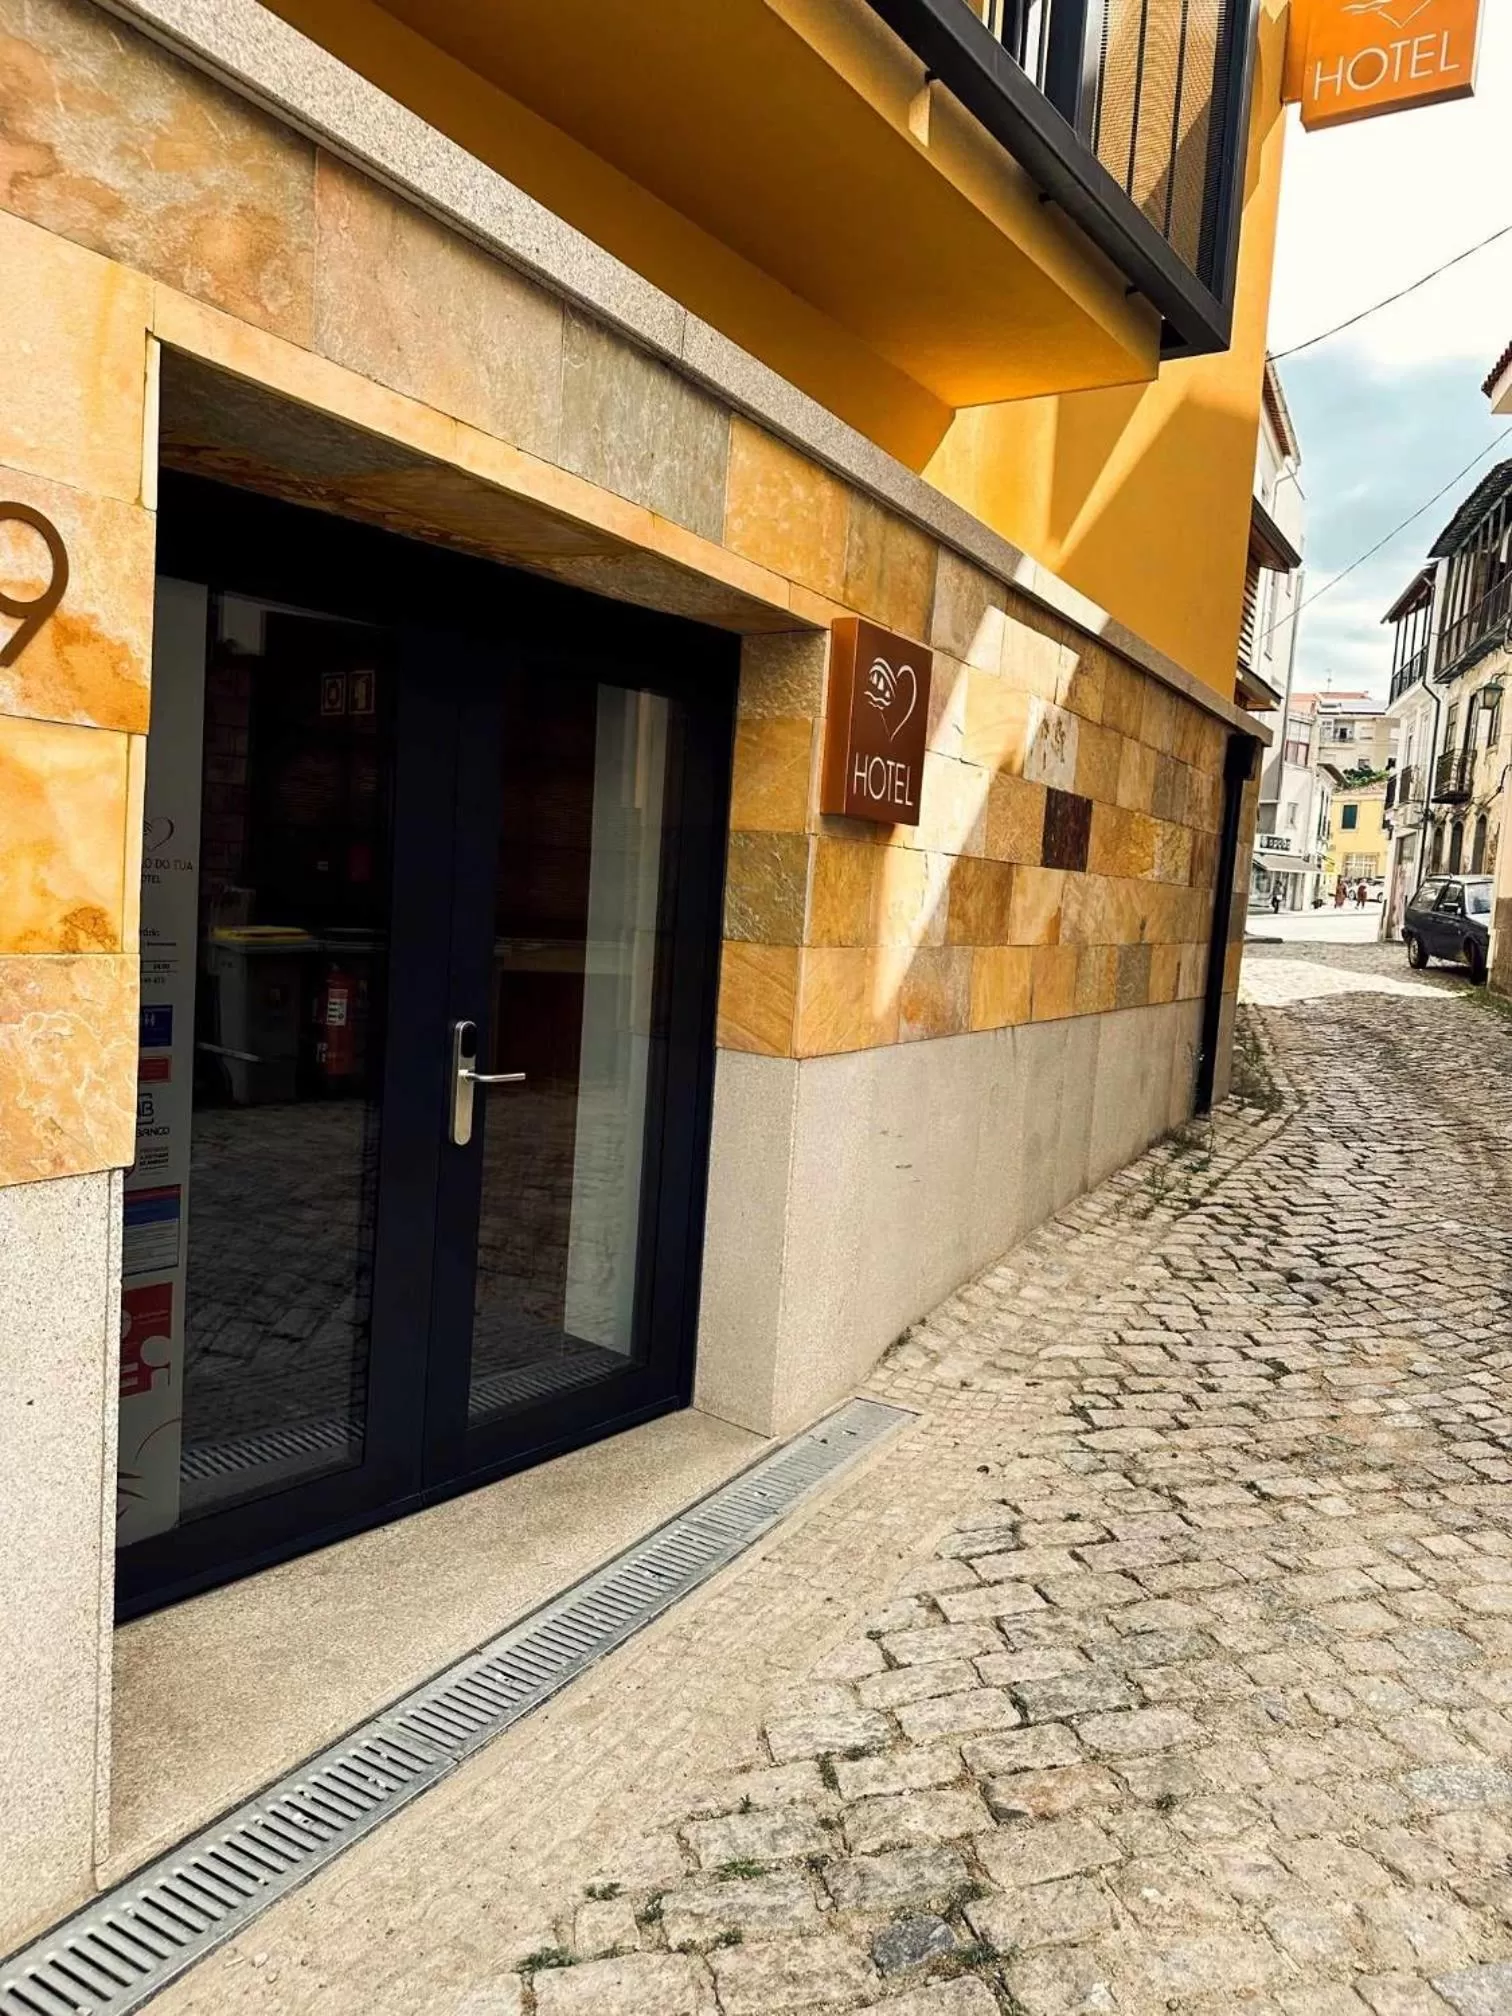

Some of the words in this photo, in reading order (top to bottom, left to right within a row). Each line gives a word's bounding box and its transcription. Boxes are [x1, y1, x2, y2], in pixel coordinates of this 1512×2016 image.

[1313, 30, 1460, 101] HOTEL
[0, 500, 69, 667] 9
[853, 751, 914, 806] HOTEL
